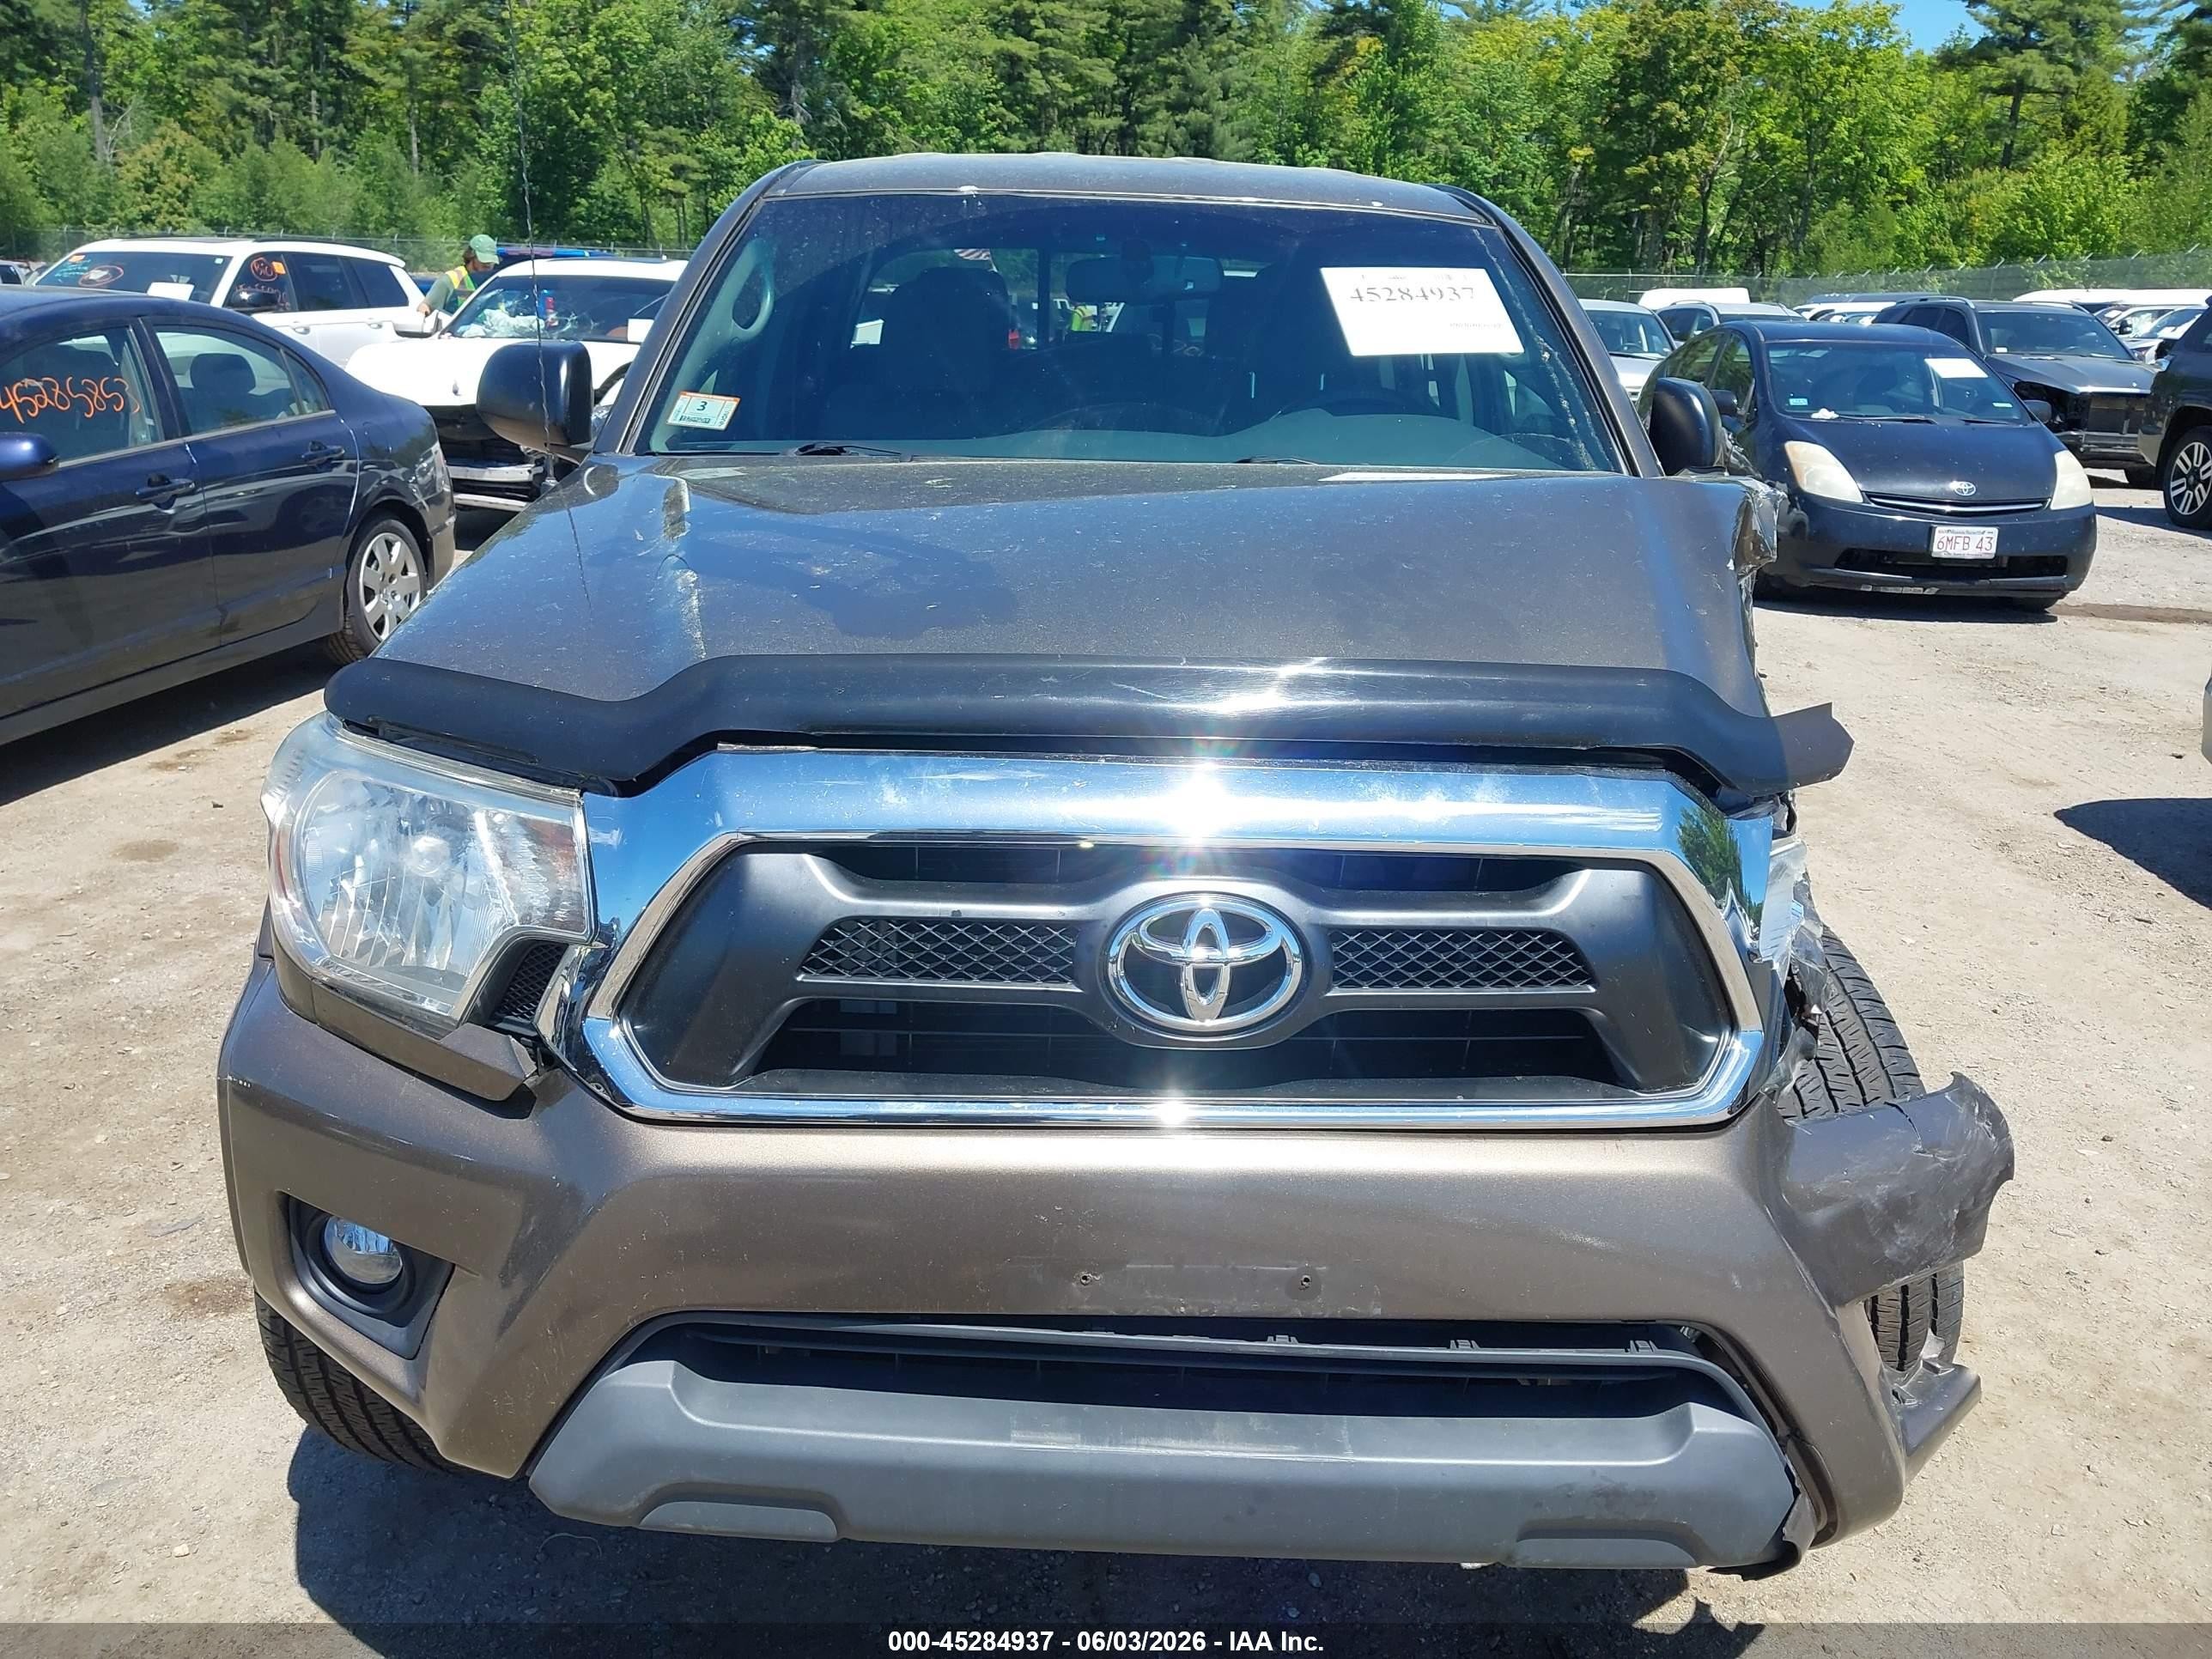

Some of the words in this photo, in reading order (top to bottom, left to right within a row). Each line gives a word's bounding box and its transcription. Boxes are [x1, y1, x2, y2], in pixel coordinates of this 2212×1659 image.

[1350, 287, 1474, 302] 45284937
[0, 376, 140, 424] 45285853
[696, 401, 708, 411] 3
[1936, 536, 1971, 550] 6MFB
[1976, 536, 1994, 551] 43
